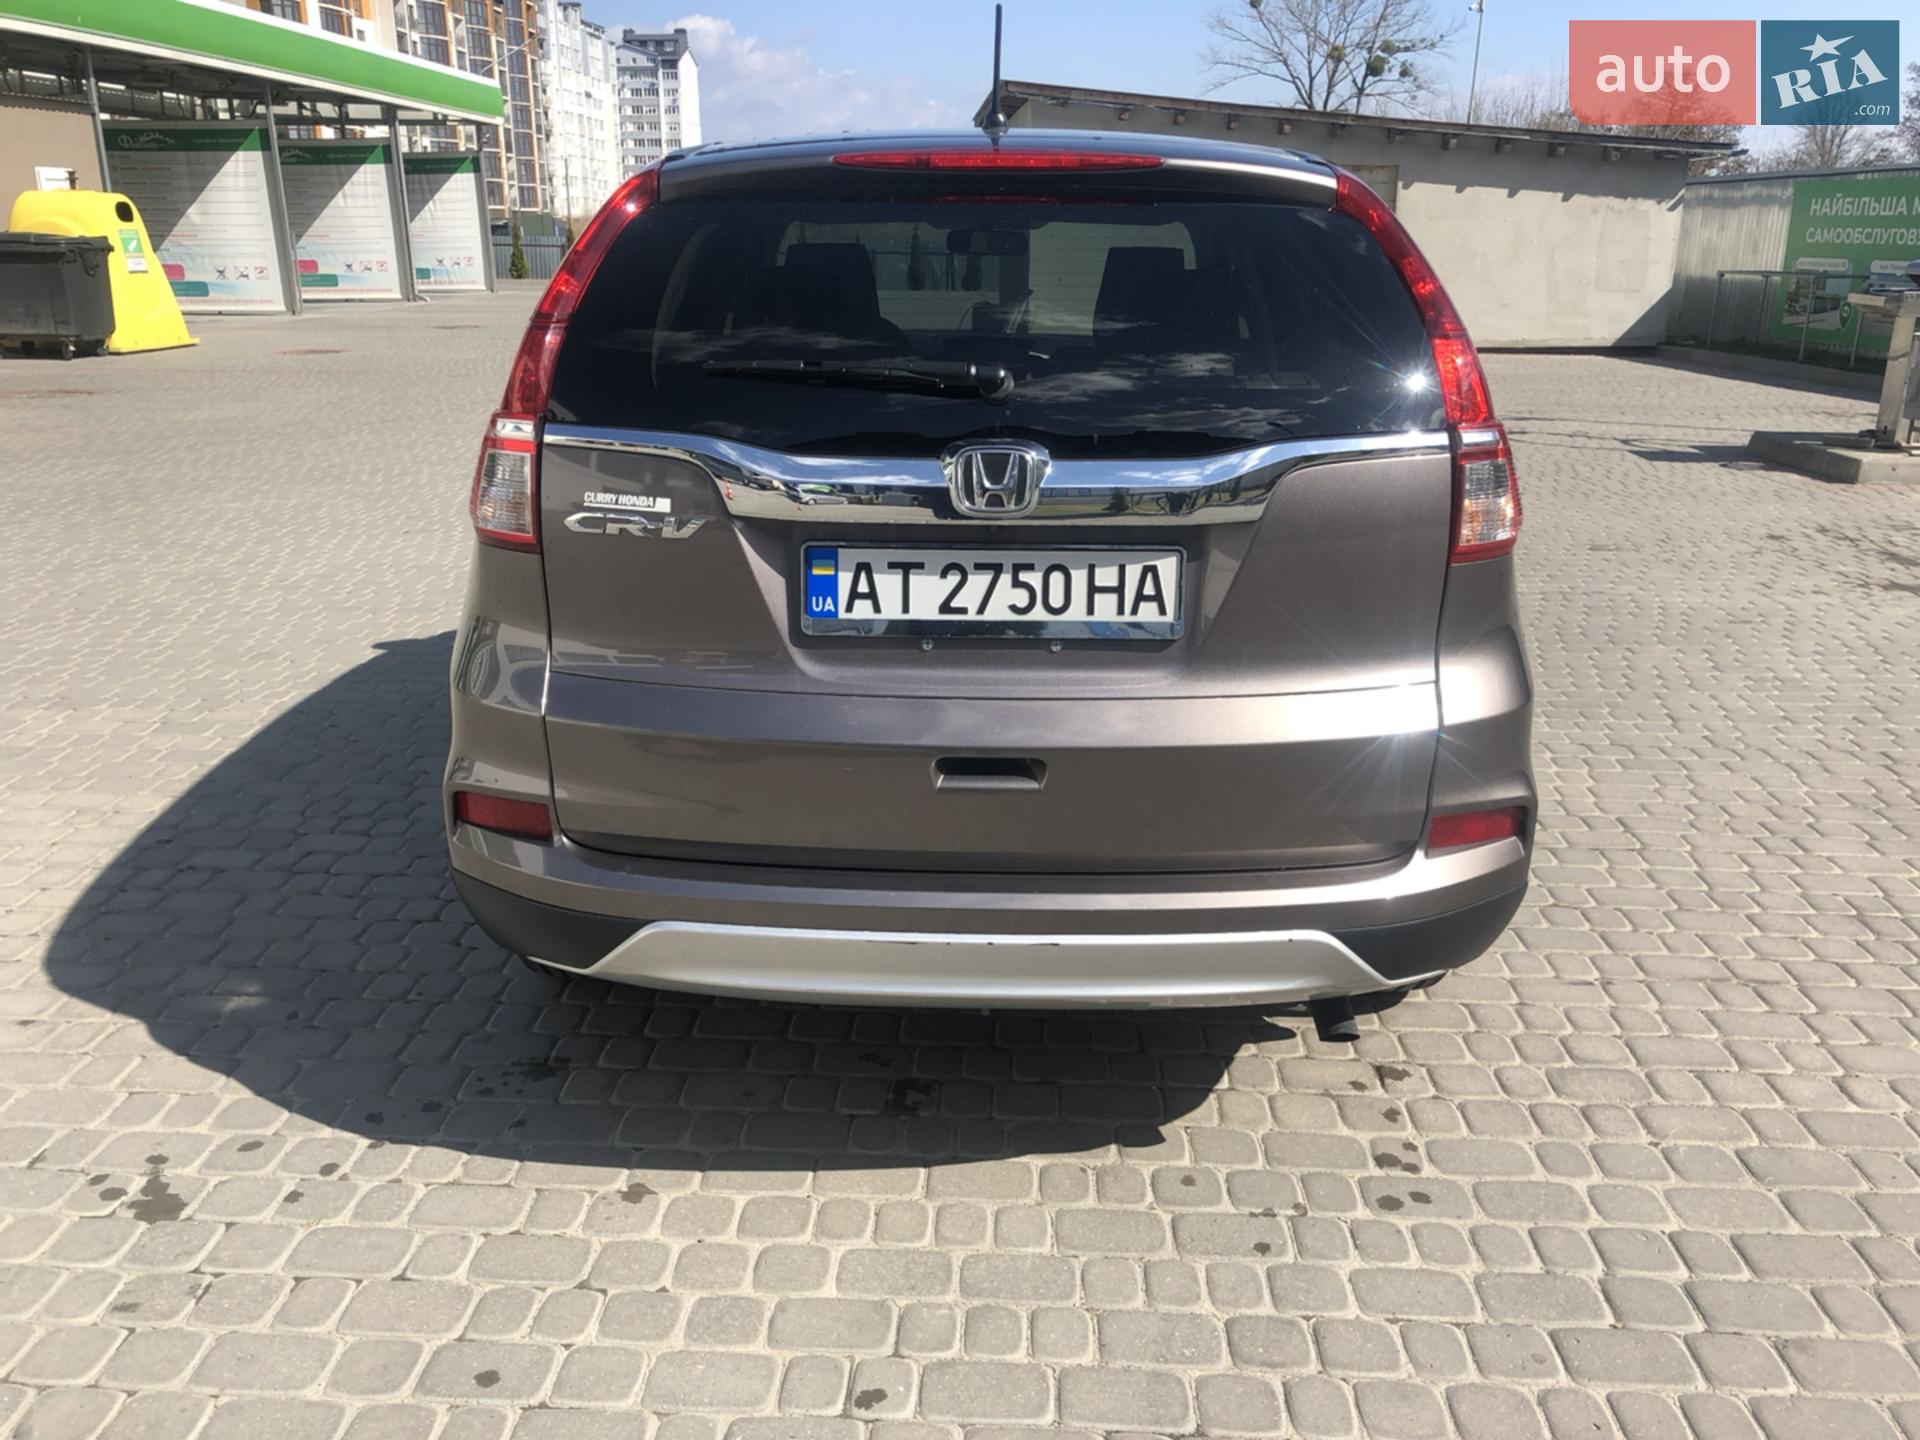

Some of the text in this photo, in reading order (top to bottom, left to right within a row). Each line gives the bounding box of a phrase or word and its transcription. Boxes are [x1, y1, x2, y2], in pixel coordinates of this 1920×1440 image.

[1809, 193, 1908, 217] НАЙБІЛЬША
[583, 491, 654, 508] CURRY HONDA
[563, 511, 709, 540] CR-V
[844, 561, 1168, 617] AT 2750 HA
[811, 595, 836, 612] UA
